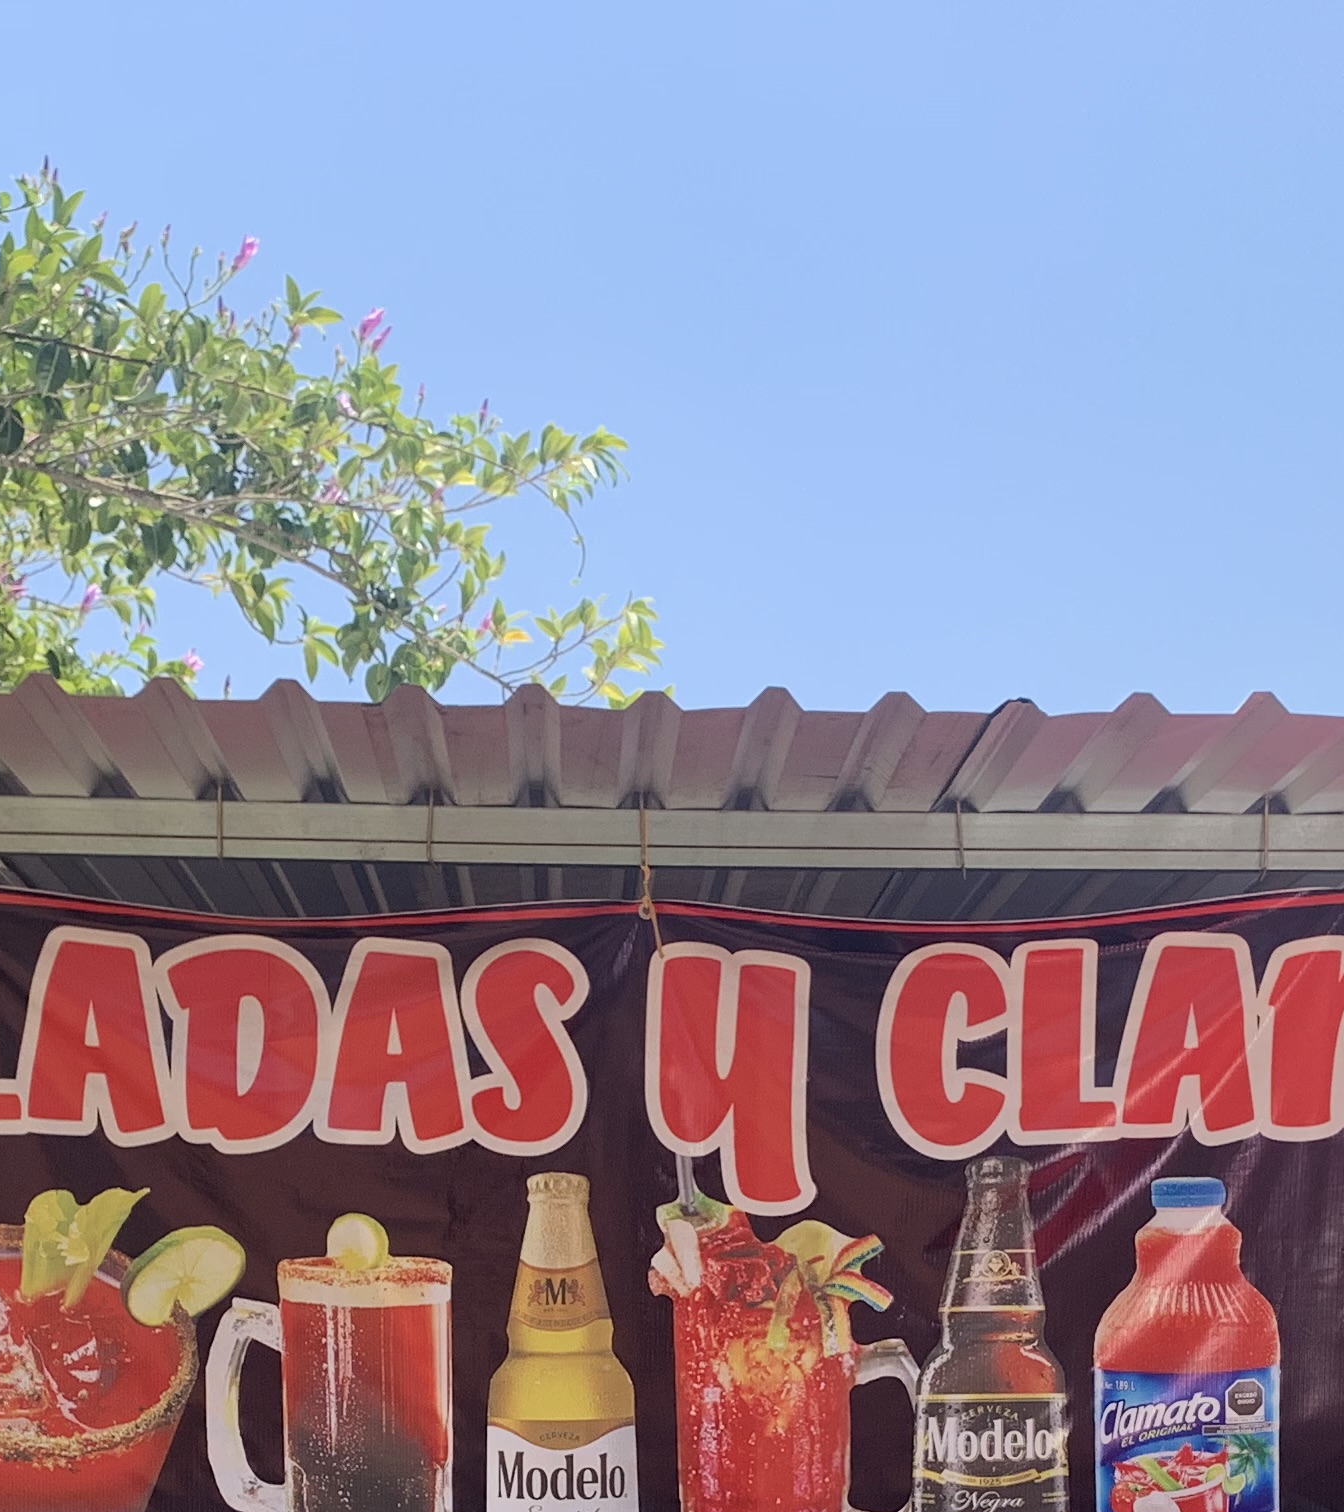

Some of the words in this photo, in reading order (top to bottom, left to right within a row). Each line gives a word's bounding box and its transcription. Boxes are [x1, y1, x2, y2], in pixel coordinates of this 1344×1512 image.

[961, 1405, 1019, 1421] CERVEZA
[1100, 1392, 1221, 1445] Clamato
[927, 1416, 1053, 1463] Modelo
[1121, 1435, 1136, 1448] EL
[498, 1450, 625, 1500] Modelo
[979, 1478, 1002, 1486] 1925
